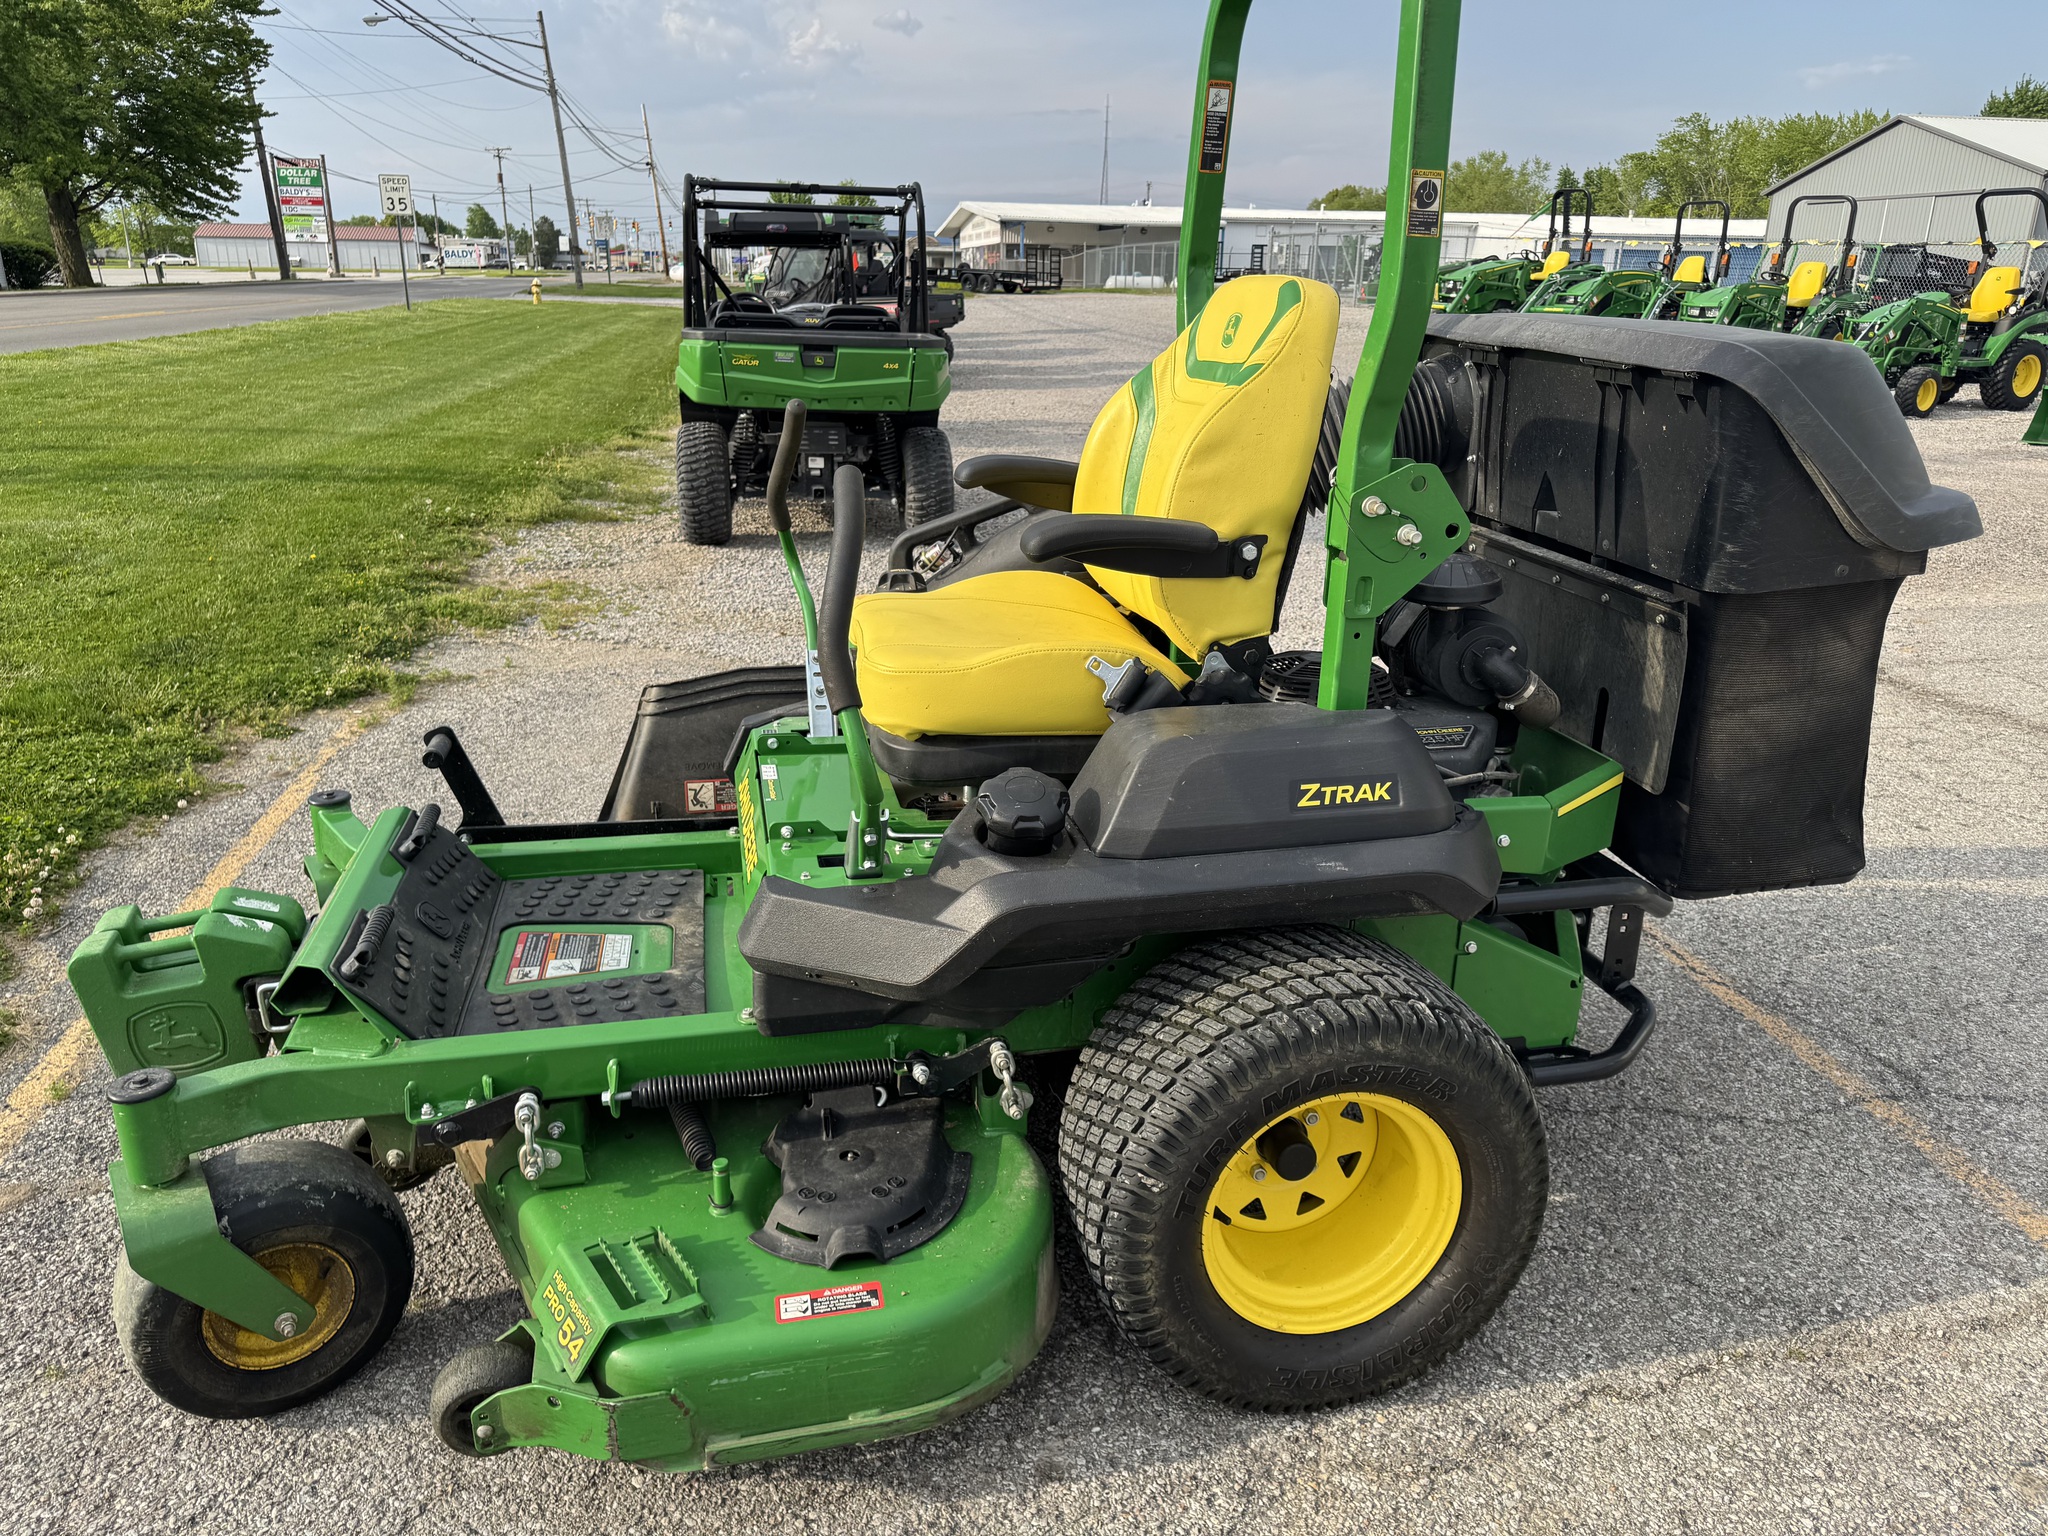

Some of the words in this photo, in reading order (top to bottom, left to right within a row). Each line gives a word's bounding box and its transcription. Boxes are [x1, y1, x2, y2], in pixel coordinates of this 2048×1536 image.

[279, 169, 318, 178] DOLLAR
[287, 177, 311, 185] TREE
[381, 177, 408, 186] SPEED
[280, 188, 311, 196] BALDY'S
[386, 196, 408, 212] 35
[731, 358, 760, 367] GATOR
[1444, 733, 1465, 742] HP
[1297, 781, 1393, 807] ZTRAK
[1173, 1111, 1249, 1221] TURF
[1260, 1064, 1459, 1117] MASTER
[831, 1284, 863, 1294] DANGER
[552, 1269, 568, 1295] High
[565, 1290, 593, 1336] Capacity
[817, 1294, 847, 1302] ROTATING
[542, 1284, 565, 1322] PRO
[558, 1316, 585, 1362] 54
[1266, 1281, 1482, 1390] CARLISLE
